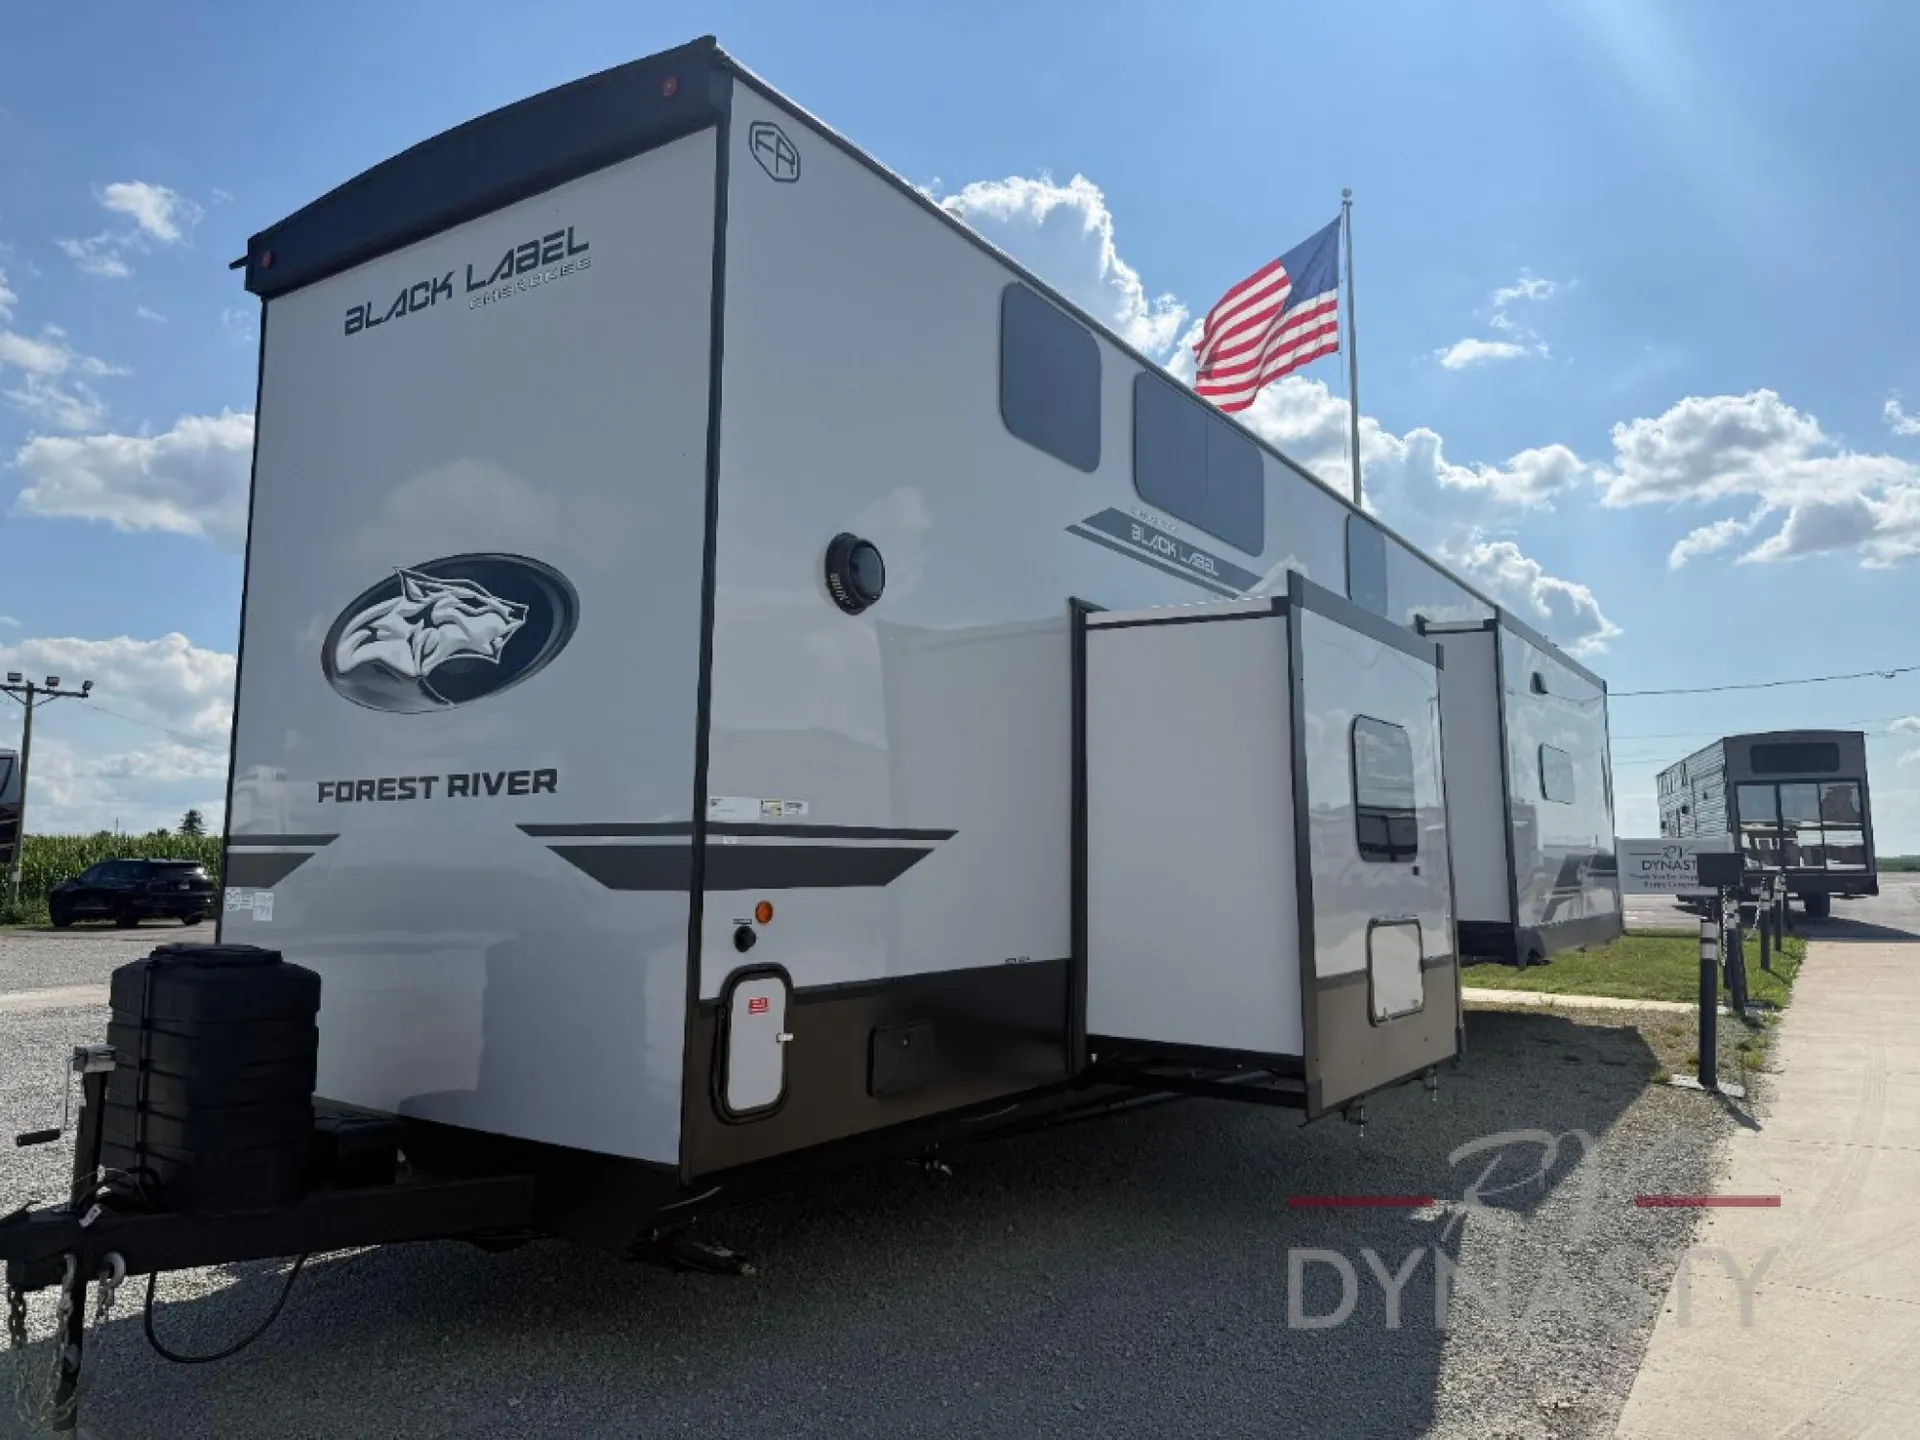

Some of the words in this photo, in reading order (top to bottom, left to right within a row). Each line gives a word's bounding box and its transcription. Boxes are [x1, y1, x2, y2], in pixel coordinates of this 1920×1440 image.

[344, 270, 455, 336] BLACK
[465, 226, 590, 293] LABEL
[1131, 523, 1177, 558] BLACK
[317, 775, 440, 803] FOREST
[447, 768, 558, 798] RIVER
[1642, 860, 1698, 871] DYNAST
